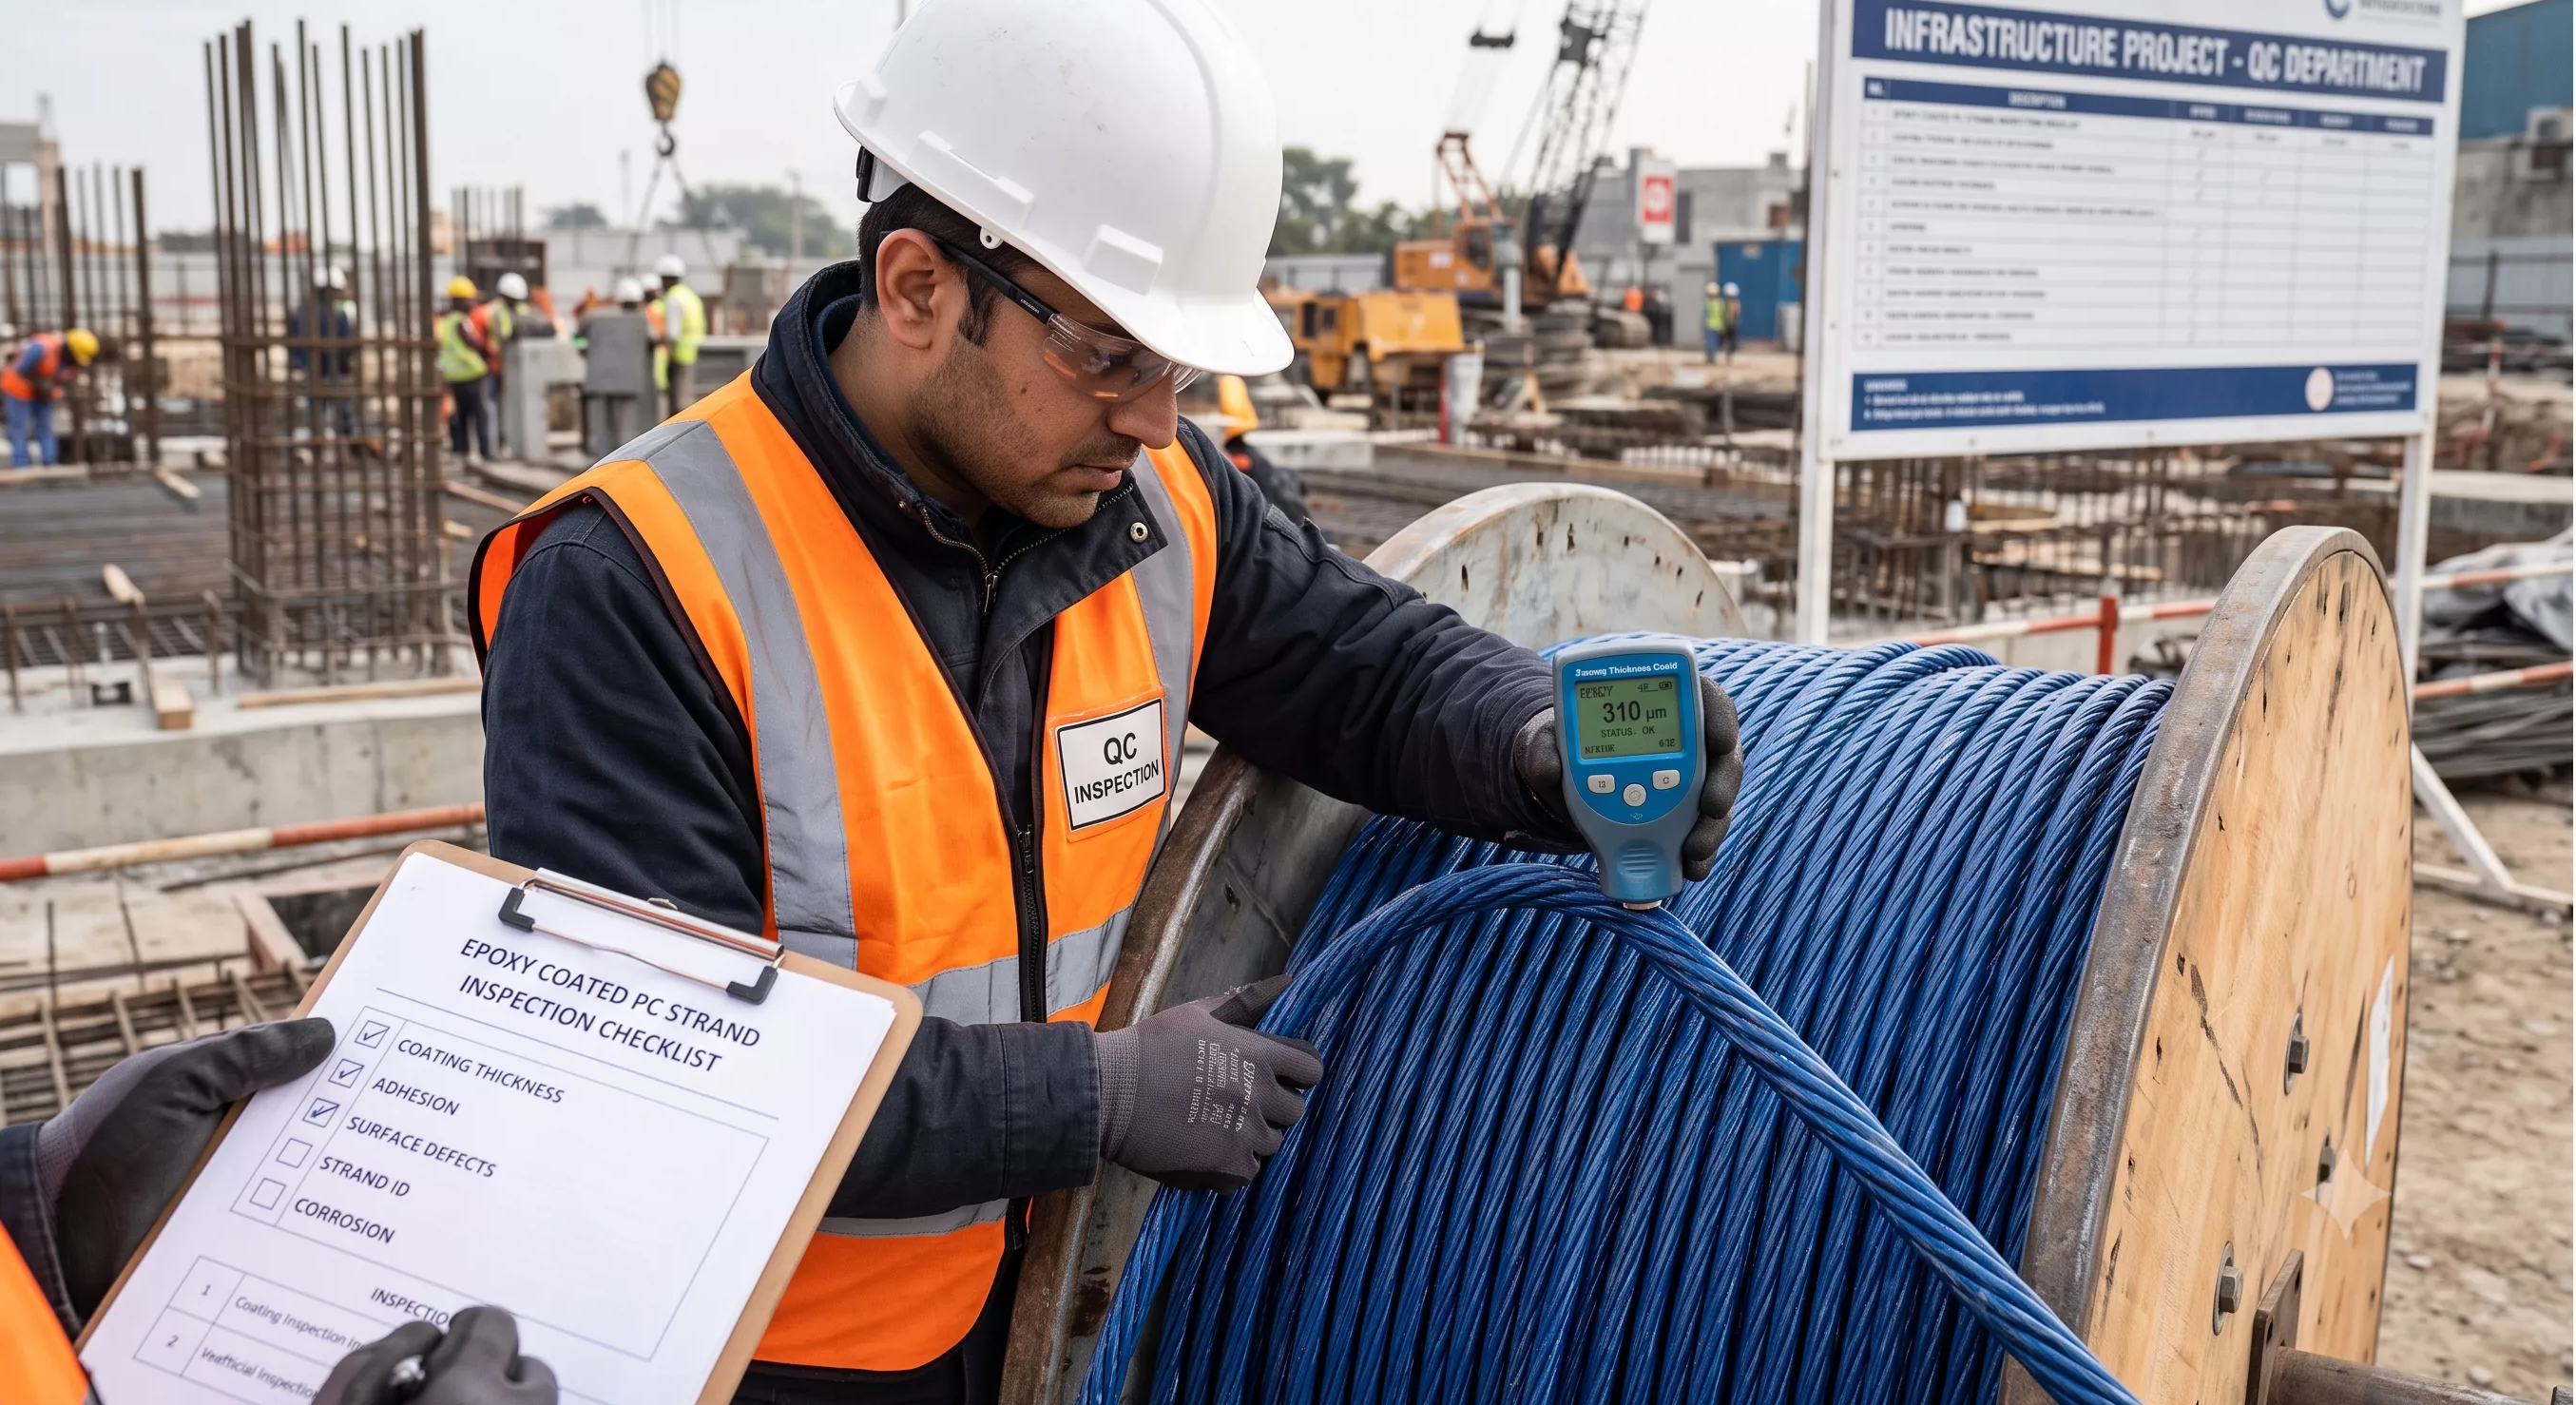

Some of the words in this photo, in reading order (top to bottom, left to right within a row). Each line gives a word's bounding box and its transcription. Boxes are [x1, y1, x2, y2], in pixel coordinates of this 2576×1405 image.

[1885, 8, 2117, 67] INFRASTRUCTURE
[2123, 29, 2229, 77] PROJECT
[2248, 41, 2281, 83] QC
[2283, 45, 2427, 93] DEPARTMENT
[1603, 701, 1641, 723] 310
[1642, 725, 1656, 735] OK
[1104, 732, 1137, 765] QC
[1074, 760, 1159, 803] INSPECTION
[460, 938, 538, 974] EPOXY
[537, 964, 628, 1004] COATED
[631, 992, 664, 1016] PC
[665, 1004, 760, 1047] STRAND
[459, 975, 596, 1031] INSPECTION
[599, 1020, 722, 1072] CHECKLIST
[397, 1039, 472, 1073] COATING
[474, 1063, 566, 1104] THICKNESS
[372, 1077, 460, 1115] ADHESION
[346, 1116, 424, 1153] SURFACE
[423, 1143, 497, 1178] DEFECTS
[319, 1156, 389, 1190] STRAND
[390, 1180, 411, 1197] ID
[294, 1198, 395, 1244] CORROSION
[201, 1283, 211, 1296] 1
[371, 1287, 450, 1325] INSPECTIO
[166, 1335, 179, 1348] 2
[235, 1297, 282, 1325] Coating
[282, 1314, 347, 1346] Inspection
